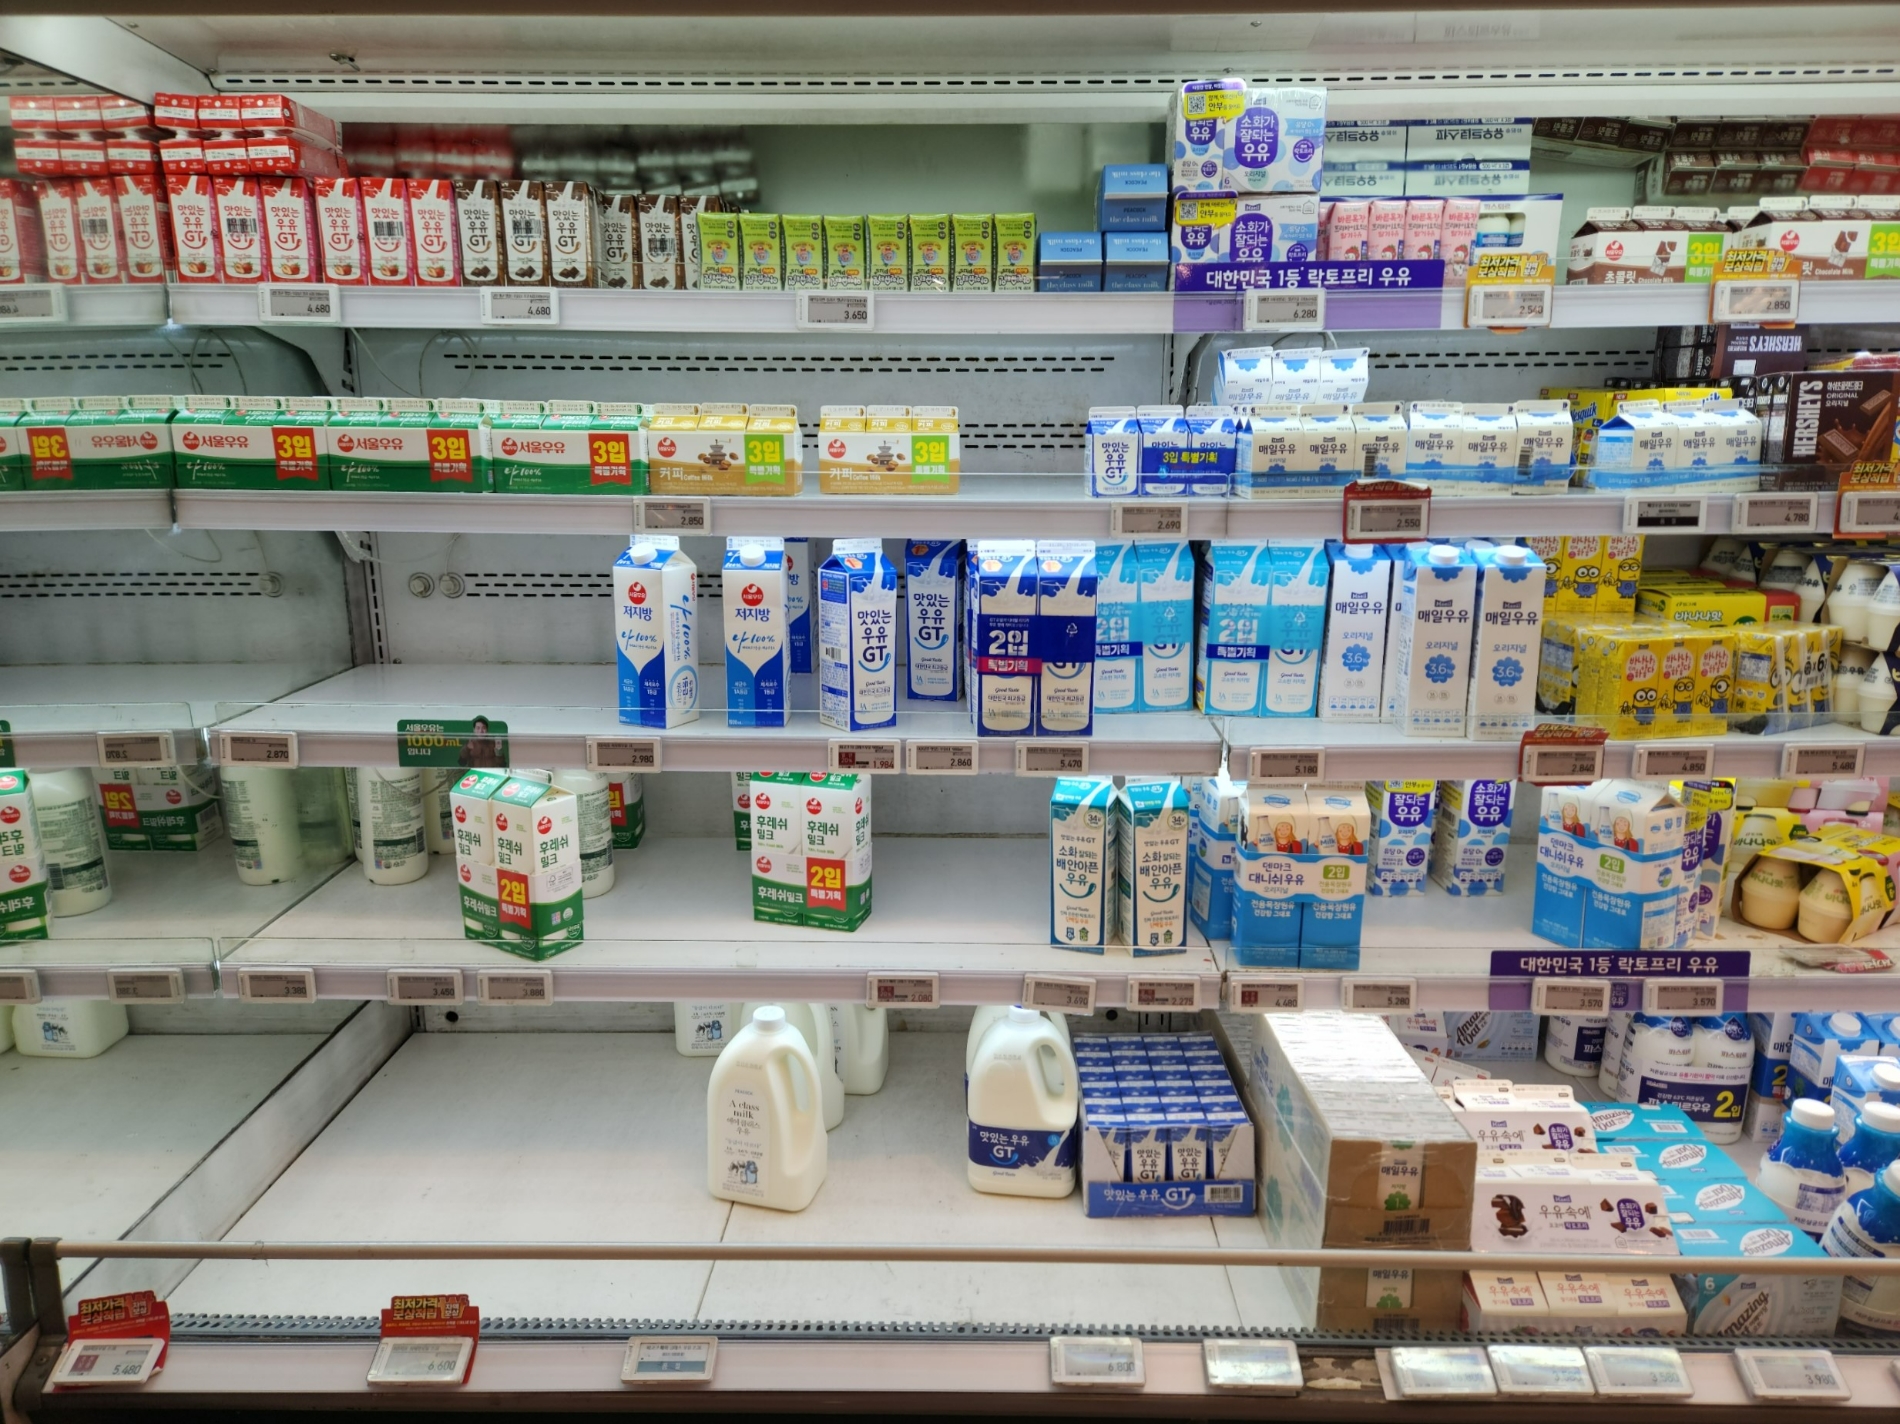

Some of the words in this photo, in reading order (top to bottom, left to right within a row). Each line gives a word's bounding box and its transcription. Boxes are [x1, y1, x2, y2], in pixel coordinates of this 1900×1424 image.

[1242, 116, 1274, 128] 소화가
[1190, 128, 1210, 140] 우유
[1240, 130, 1273, 142] 잘되는
[178, 205, 205, 215] 맛있는
[325, 207, 351, 218] 맛있는
[418, 209, 445, 220] 맛있는
[183, 218, 202, 230] 우유
[330, 219, 350, 230] 우유
[1236, 221, 1269, 233] 소화가
[185, 231, 204, 243] GT
[278, 233, 298, 244] GT
[332, 233, 349, 244] GT
[1235, 234, 1268, 247] 잘되는
[1207, 270, 1272, 288] 대한민국
[1278, 269, 1300, 288] 1등
[1308, 269, 1372, 286] 락토프리
[1379, 269, 1411, 285] 우유
[1604, 269, 1636, 284] 초콜릿
[1793, 380, 1823, 457] HERSHEY'S
[201, 436, 248, 448] 서울우유
[278, 435, 311, 458] 3입
[356, 437, 403, 450] 서울우유
[433, 437, 466, 459] 3입
[519, 441, 565, 453] 서울우유
[1102, 442, 1129, 453] 맛있는
[1415, 440, 1454, 450] 매일우유
[1468, 442, 1508, 452] 매일우유
[1639, 439, 1672, 449] 매일우유
[1684, 438, 1715, 448] 매일우유
[593, 441, 625, 462] 3입
[749, 441, 780, 463] 3입
[915, 442, 945, 462] 3입
[1310, 444, 1347, 454] 매일우유
[1105, 453, 1127, 465] 우유
[1163, 452, 1178, 463] 3입
[1181, 451, 1218, 464] 특별기획
[660, 468, 683, 481] 커피
[749, 465, 780, 475] 특별기획
[830, 468, 851, 480] 커피
[1106, 467, 1125, 478] GT
[914, 593, 949, 608] 맛있는
[624, 607, 652, 621] 저지방
[1336, 602, 1383, 615] 매일우유
[735, 609, 770, 621] 저지방
[858, 610, 892, 625] 맛있는
[1418, 610, 1469, 623] 매일우유
[1486, 612, 1538, 625] 매일우유
[1674, 611, 1723, 622] 바나나맛
[636, 633, 657, 642] 100%
[751, 635, 775, 643] 100%
[919, 626, 944, 641] GT
[1343, 632, 1373, 641] 오리지널
[989, 630, 1028, 655] 2입
[1426, 642, 1458, 650] 오리지널
[1493, 644, 1527, 653] 오리지널
[863, 646, 887, 662] GT
[1217, 646, 1256, 658] 특별기획
[988, 660, 1028, 671] 특별기획
[988, 695, 1006, 703] 대한민국
[1047, 695, 1064, 703] 대한민국
[405, 724, 443, 732] 서울우유는
[1475, 782, 1507, 794] 소화가
[1395, 794, 1426, 805] 잘되는
[1474, 794, 1505, 806] 잘되는
[757, 815, 788, 830] 후레쉬
[807, 820, 839, 836] 후레쉬
[758, 829, 774, 840] 밀크
[808, 834, 825, 846] 밀크
[459, 845, 472, 855] 밀크
[498, 837, 522, 855] 후레쉬
[540, 835, 569, 853] 후레쉬
[1550, 838, 1574, 852] 덴마크
[1059, 846, 1077, 856] 소화
[1078, 850, 1097, 859] 잘되는
[1142, 852, 1161, 862] 소화
[1163, 852, 1181, 861] 잘되는
[1539, 845, 1584, 869] 대니쉬우유
[498, 853, 512, 865] 밀크
[1604, 857, 1620, 871] 2입
[1263, 862, 1292, 872] 덴마크
[1328, 867, 1345, 878] 2입
[810, 866, 841, 888] 2입
[1066, 874, 1088, 885] 우유
[1150, 877, 1172, 889] 우유
[1249, 873, 1304, 885] 대니쉬우유
[500, 879, 526, 905] 2입
[758, 887, 803, 904] 후레쉬밀크
[810, 889, 841, 900] 특별기획
[1264, 886, 1288, 894] 오리지널
[464, 895, 497, 917] 후레쉬밀크
[502, 904, 527, 917] 특별기획
[1251, 900, 1294, 910] 전용목장원유
[1313, 902, 1356, 912] 전용목장원유
[1521, 957, 1583, 973] 대한민국
[1590, 957, 1612, 973] 1등
[1618, 956, 1681, 972] 락토프리
[1687, 956, 1719, 971] 우유
[729, 1100, 736, 1108] A
[738, 1102, 759, 1111] class
[1714, 1091, 1741, 1118] 2입
[733, 1109, 754, 1119] milk
[979, 1132, 1010, 1143] 맛있는
[1012, 1133, 1030, 1146] 우유
[1478, 1130, 1524, 1143] 우유속에
[993, 1146, 1016, 1158] GT
[1381, 1165, 1418, 1176] 매일우유
[1103, 1189, 1136, 1202] 맛있는
[1165, 1188, 1190, 1200] GT
[1539, 1206, 1591, 1219] 우유속에
[1557, 1282, 1600, 1294] 우유속에
[1705, 1277, 1714, 1290] 6
[1489, 1286, 1531, 1297] 우유속에
[1625, 1287, 1667, 1299] 우유속에
[394, 1298, 438, 1309] 최저가격
